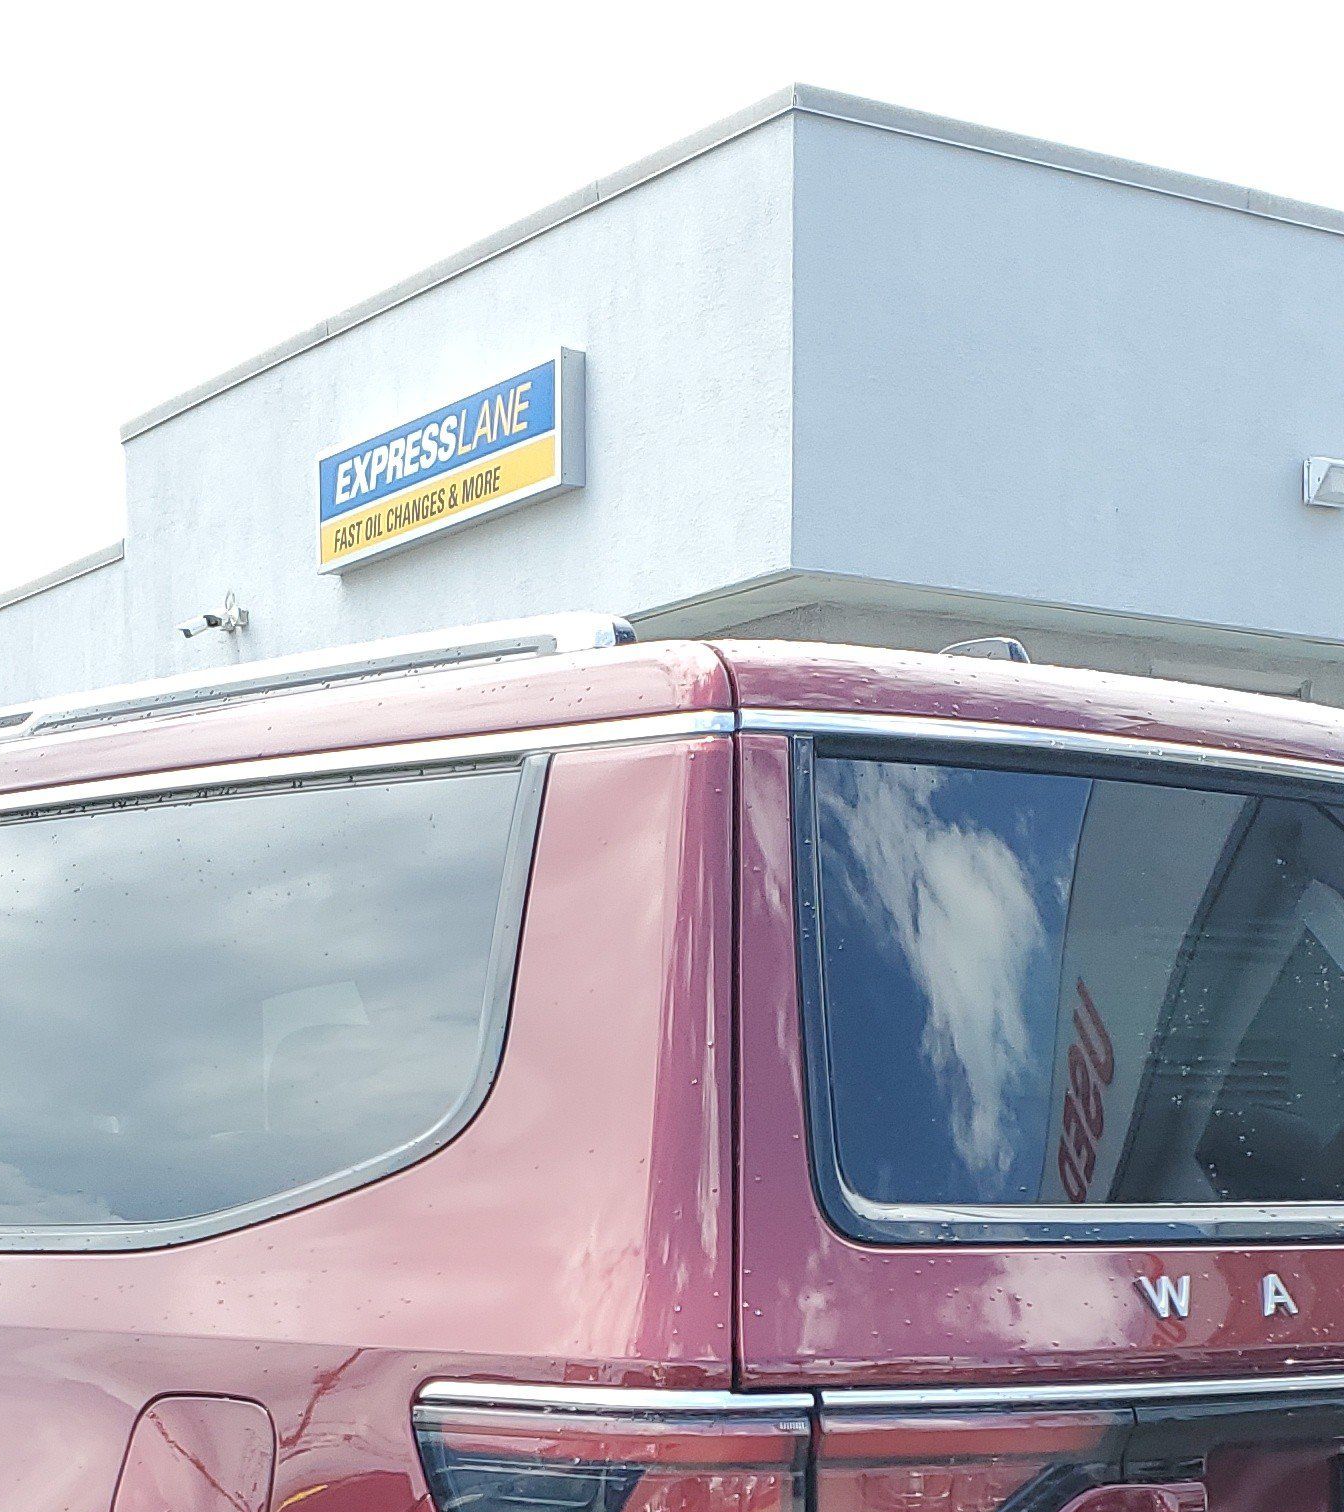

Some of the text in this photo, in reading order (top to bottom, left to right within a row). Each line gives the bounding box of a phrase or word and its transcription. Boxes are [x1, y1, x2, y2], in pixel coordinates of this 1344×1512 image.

[335, 381, 532, 505] EXPRESSLANE
[334, 466, 501, 553] FAST OIL CHANGES & MORE
